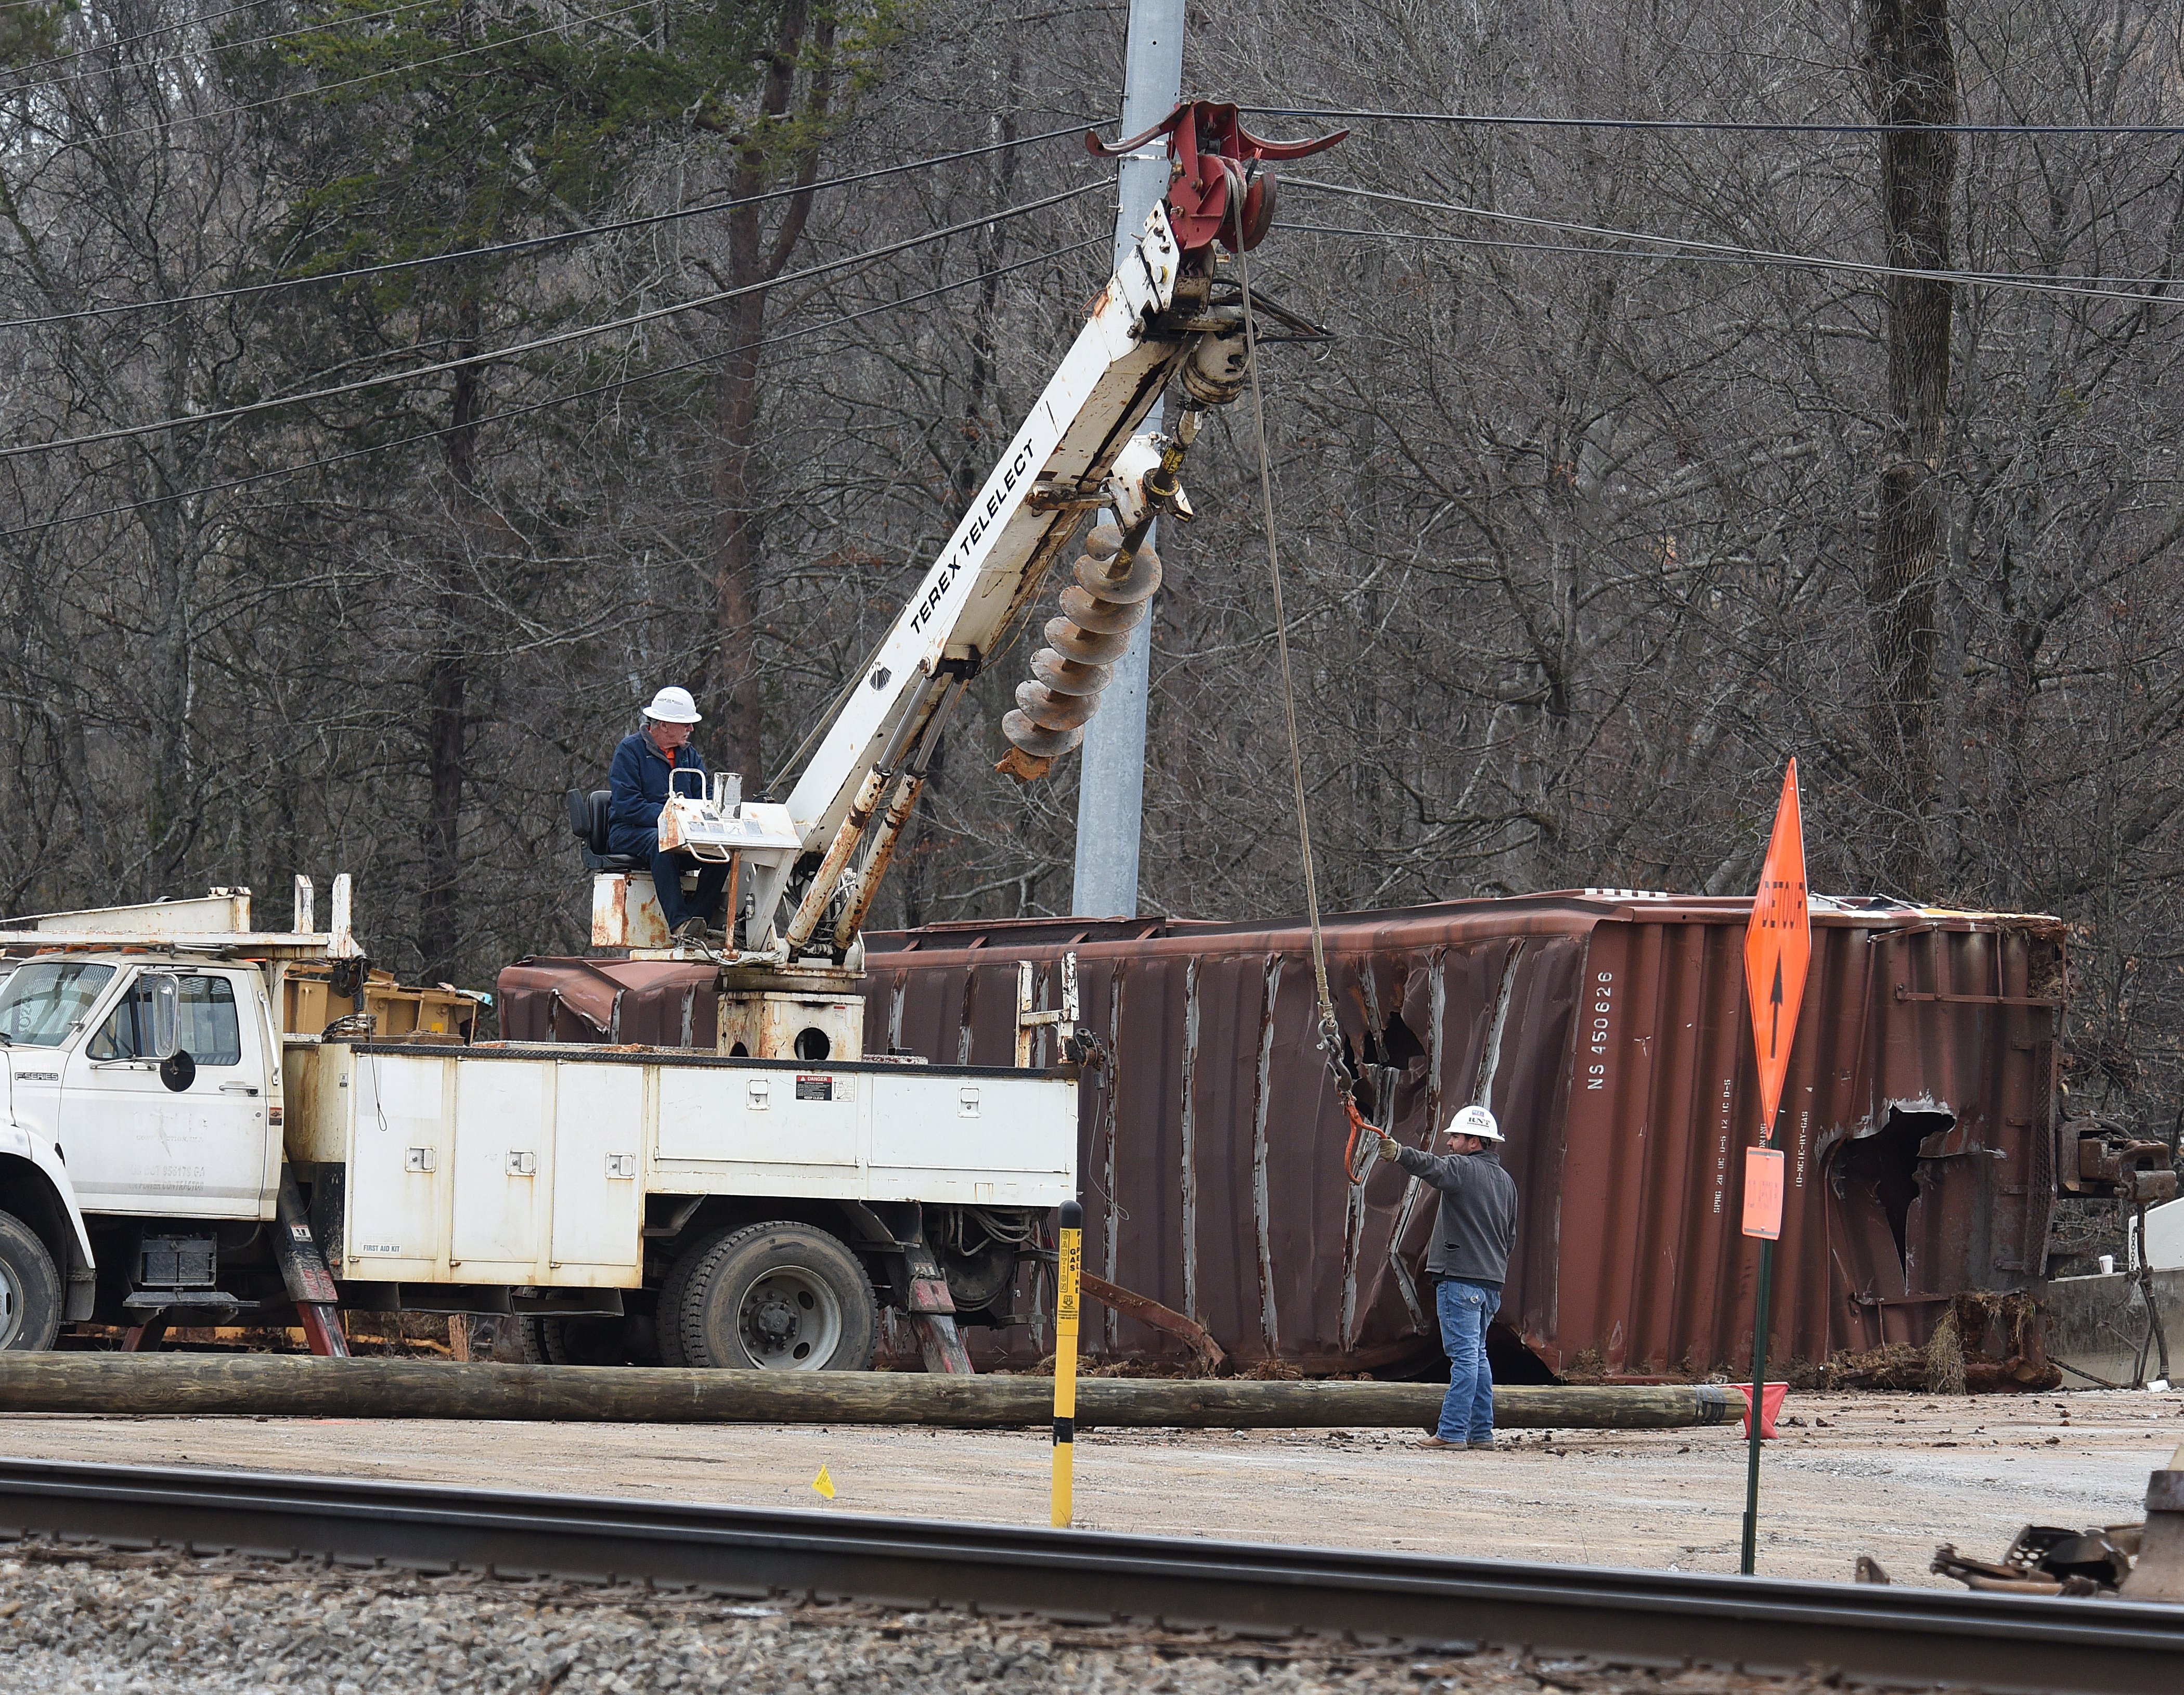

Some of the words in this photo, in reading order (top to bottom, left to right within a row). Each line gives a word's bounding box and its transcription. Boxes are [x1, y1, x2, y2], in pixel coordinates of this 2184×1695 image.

[911, 553, 961, 635] TEREX
[960, 437, 1034, 557] TELELECT
[1762, 881, 1803, 929] DETOUR
[1591, 972, 1612, 1055] 450626
[1587, 1065, 1604, 1090] NS
[1713, 1191, 1722, 1213] SPRG
